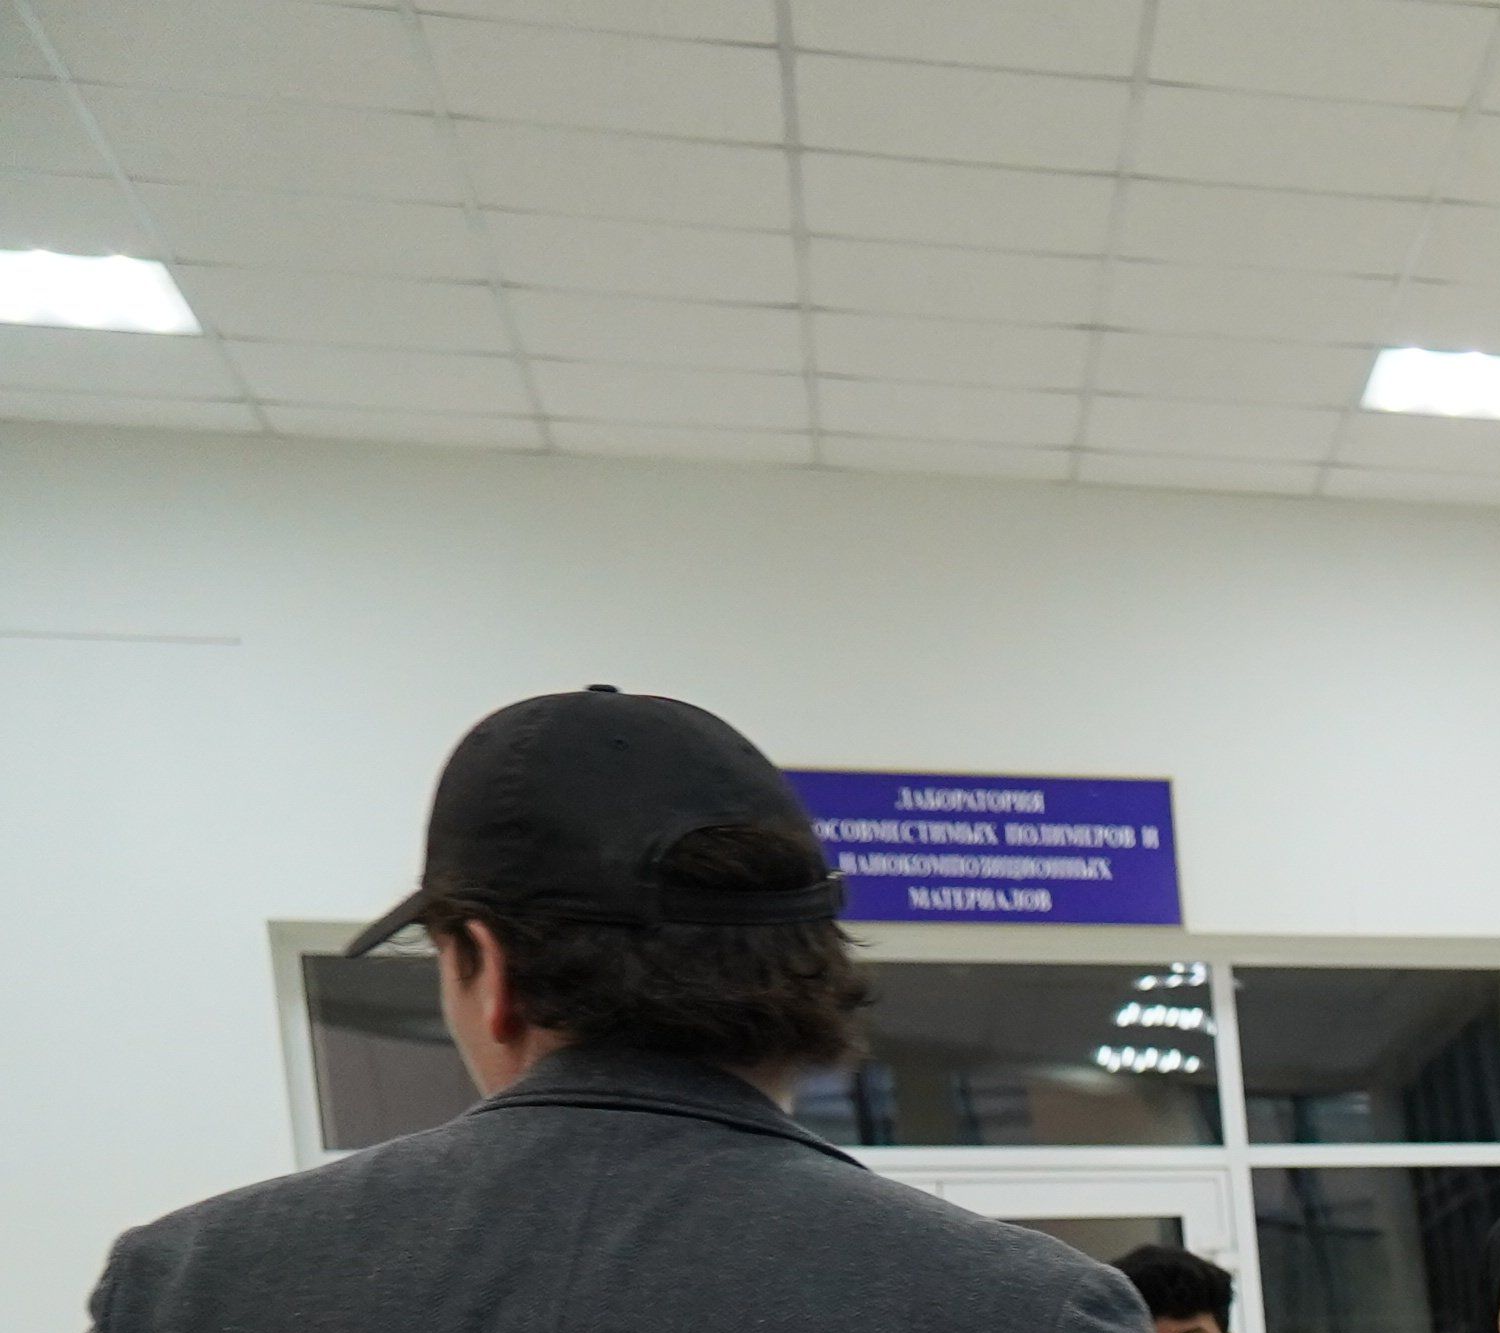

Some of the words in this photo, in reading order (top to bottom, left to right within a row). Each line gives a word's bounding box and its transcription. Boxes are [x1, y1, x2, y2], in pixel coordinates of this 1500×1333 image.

[895, 786, 1045, 814] ЛАБОРАТОРИЯ
[811, 818, 999, 845] ОСОВМЕСТИМЫХ
[1004, 822, 1136, 848] ПОЛИМЕРОВ
[1141, 825, 1160, 849] И
[908, 886, 1053, 912] МАТЕРИАЛОВ
